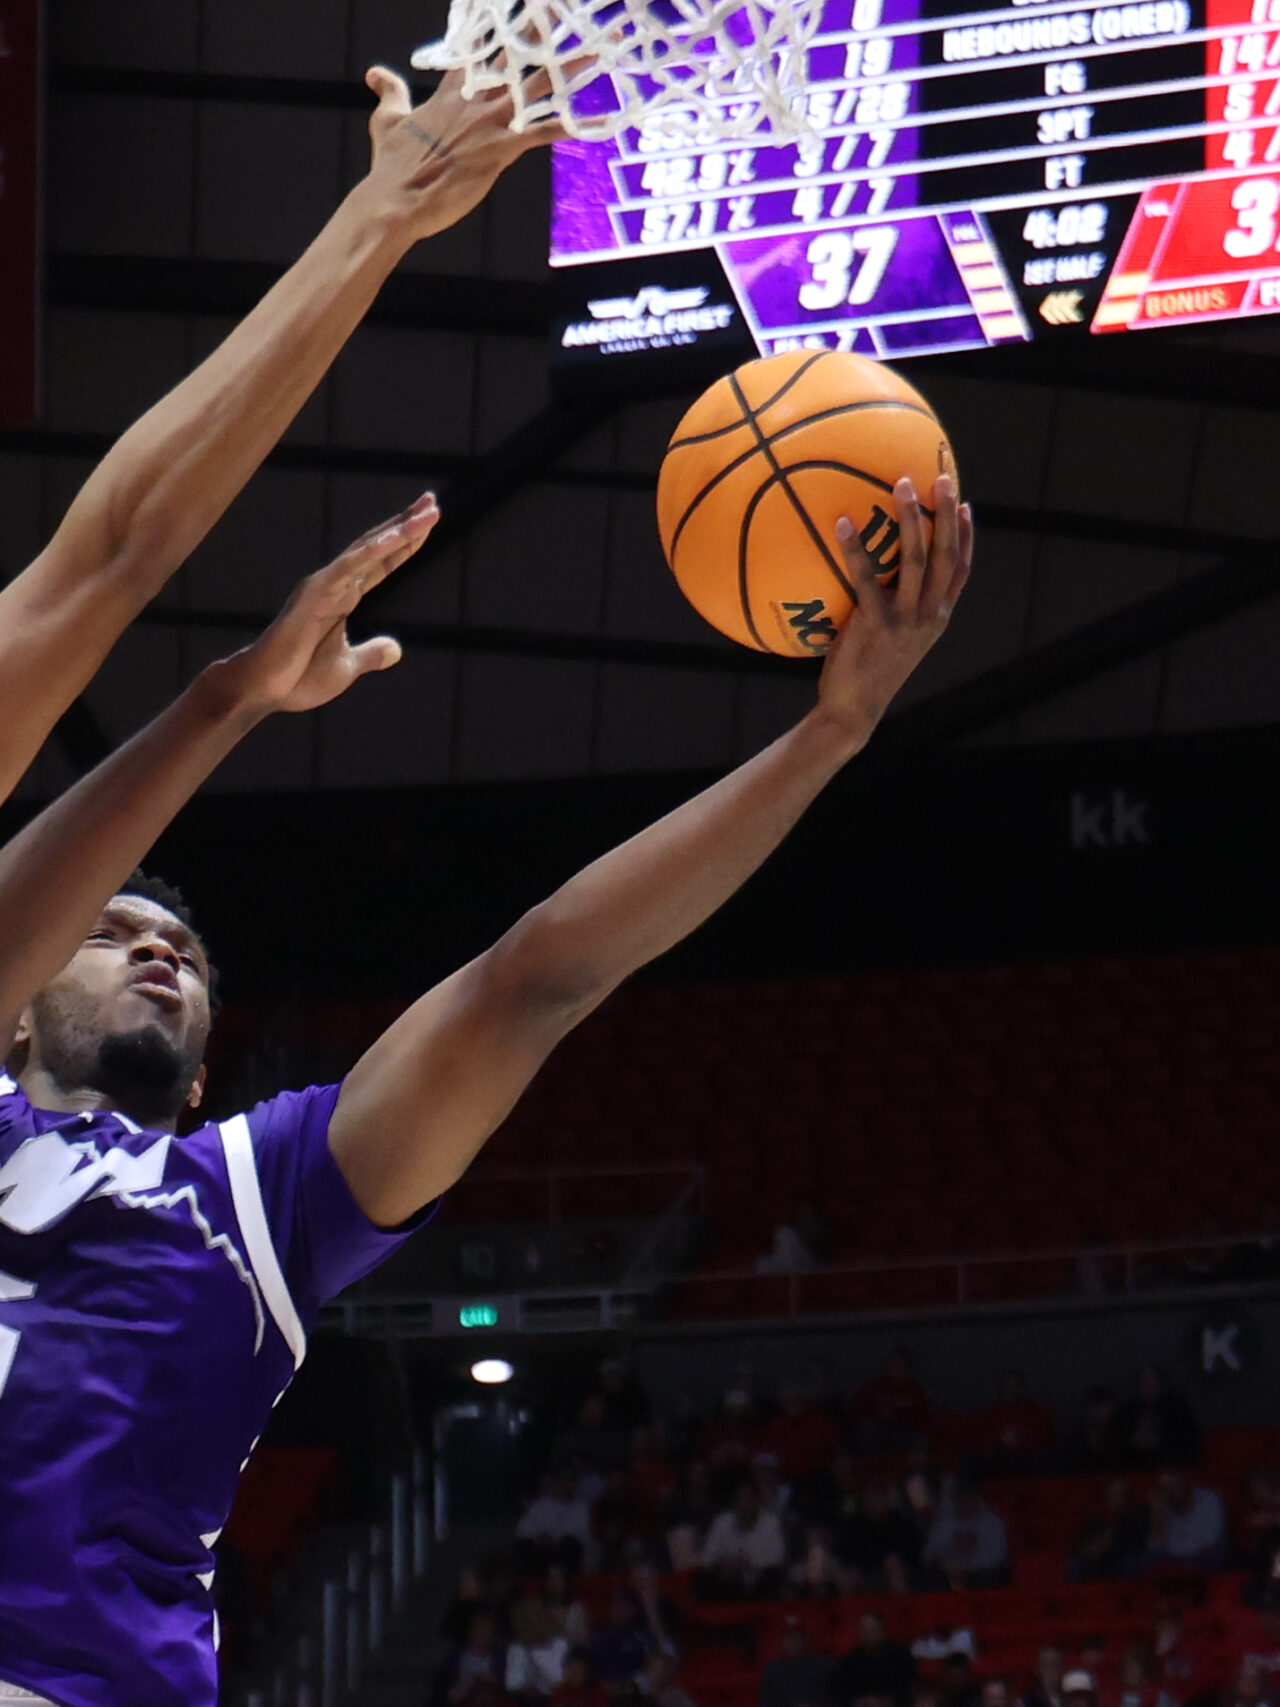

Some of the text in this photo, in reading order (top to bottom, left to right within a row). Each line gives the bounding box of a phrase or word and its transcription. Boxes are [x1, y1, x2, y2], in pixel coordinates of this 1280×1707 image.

[845, 38, 894, 79] 19
[943, 13, 1090, 62] REBOUNDS
[1091, 1, 1191, 45] (OREB)
[1044, 61, 1087, 96] FG
[1037, 106, 1094, 144] 3PT
[1045, 154, 1087, 190] FT
[1023, 203, 1108, 248] 4:02
[1223, 181, 1280, 257] 3
[799, 225, 899, 310] 37
[1023, 252, 1107, 286] 1ST HALF
[1146, 287, 1229, 318] BONUS
[1201, 1323, 1241, 1373] K
